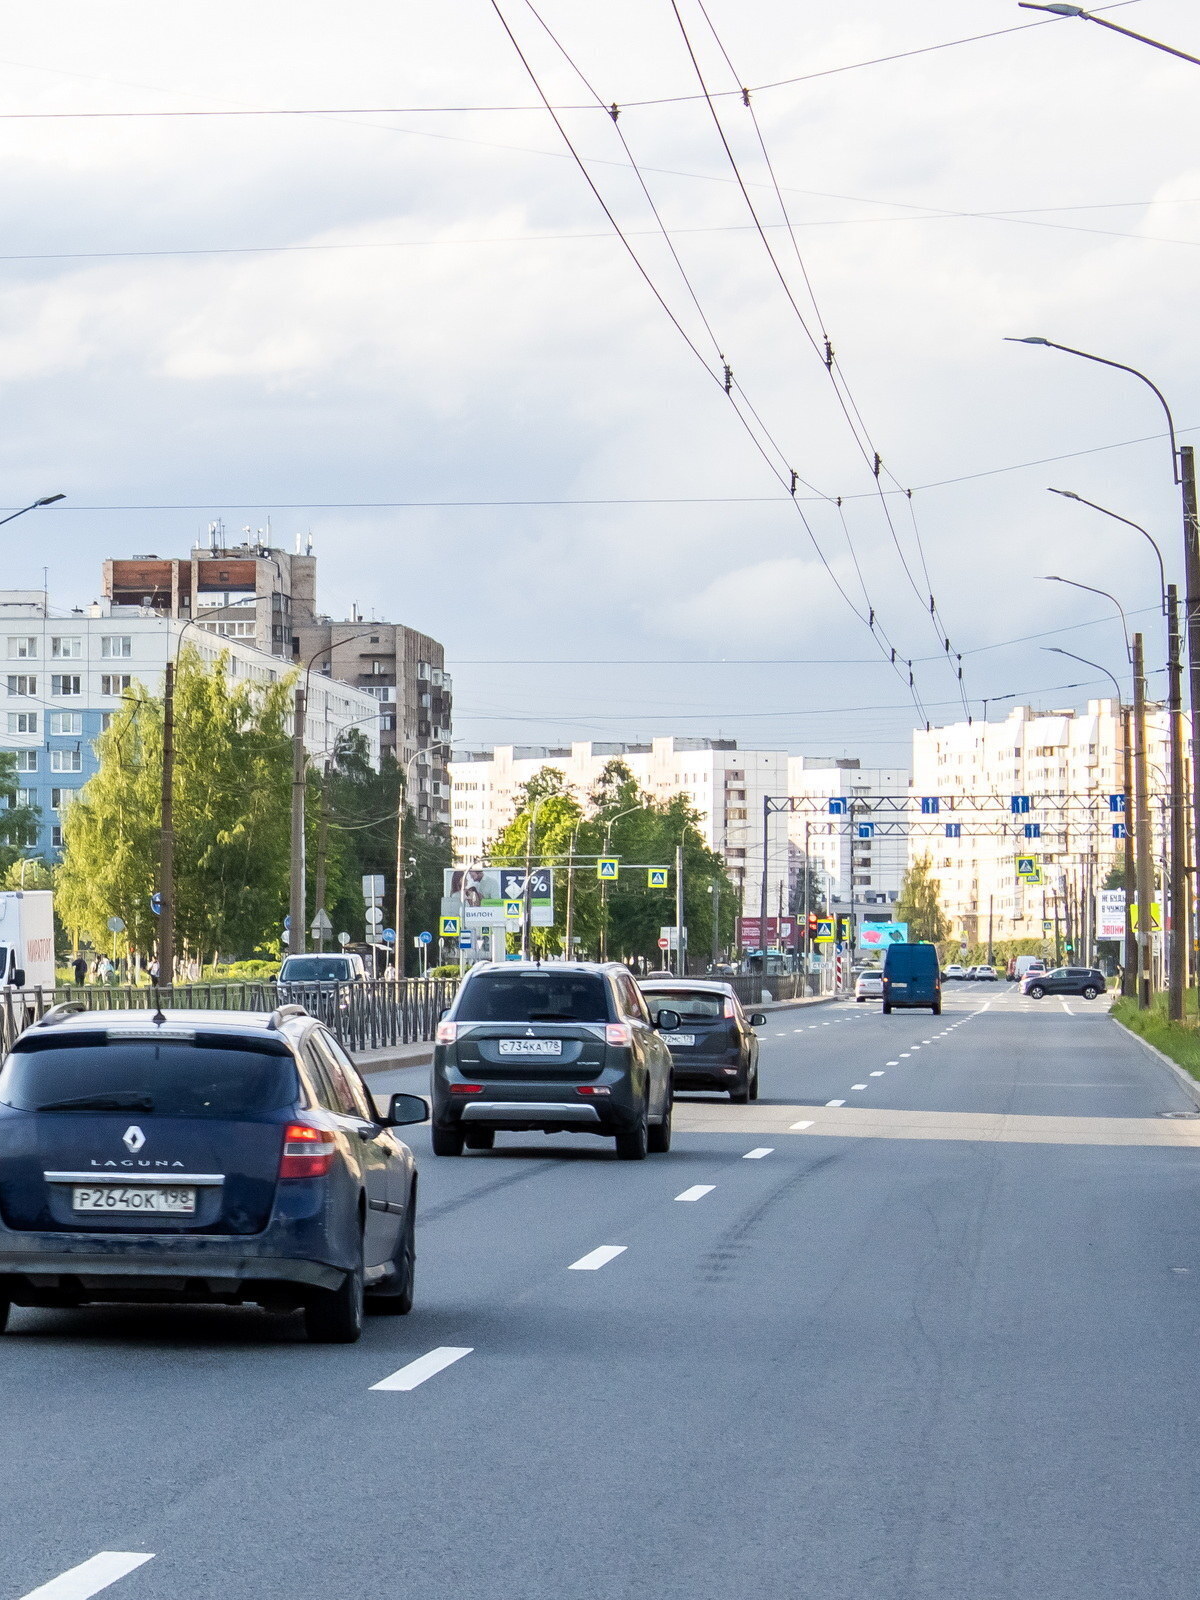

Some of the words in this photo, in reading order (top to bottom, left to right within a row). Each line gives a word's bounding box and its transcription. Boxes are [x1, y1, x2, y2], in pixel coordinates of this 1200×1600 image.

[90, 1159, 185, 1167] LAGUNA
[79, 1188, 156, 1209] Р264ОК
[160, 1188, 190, 1204] 198
